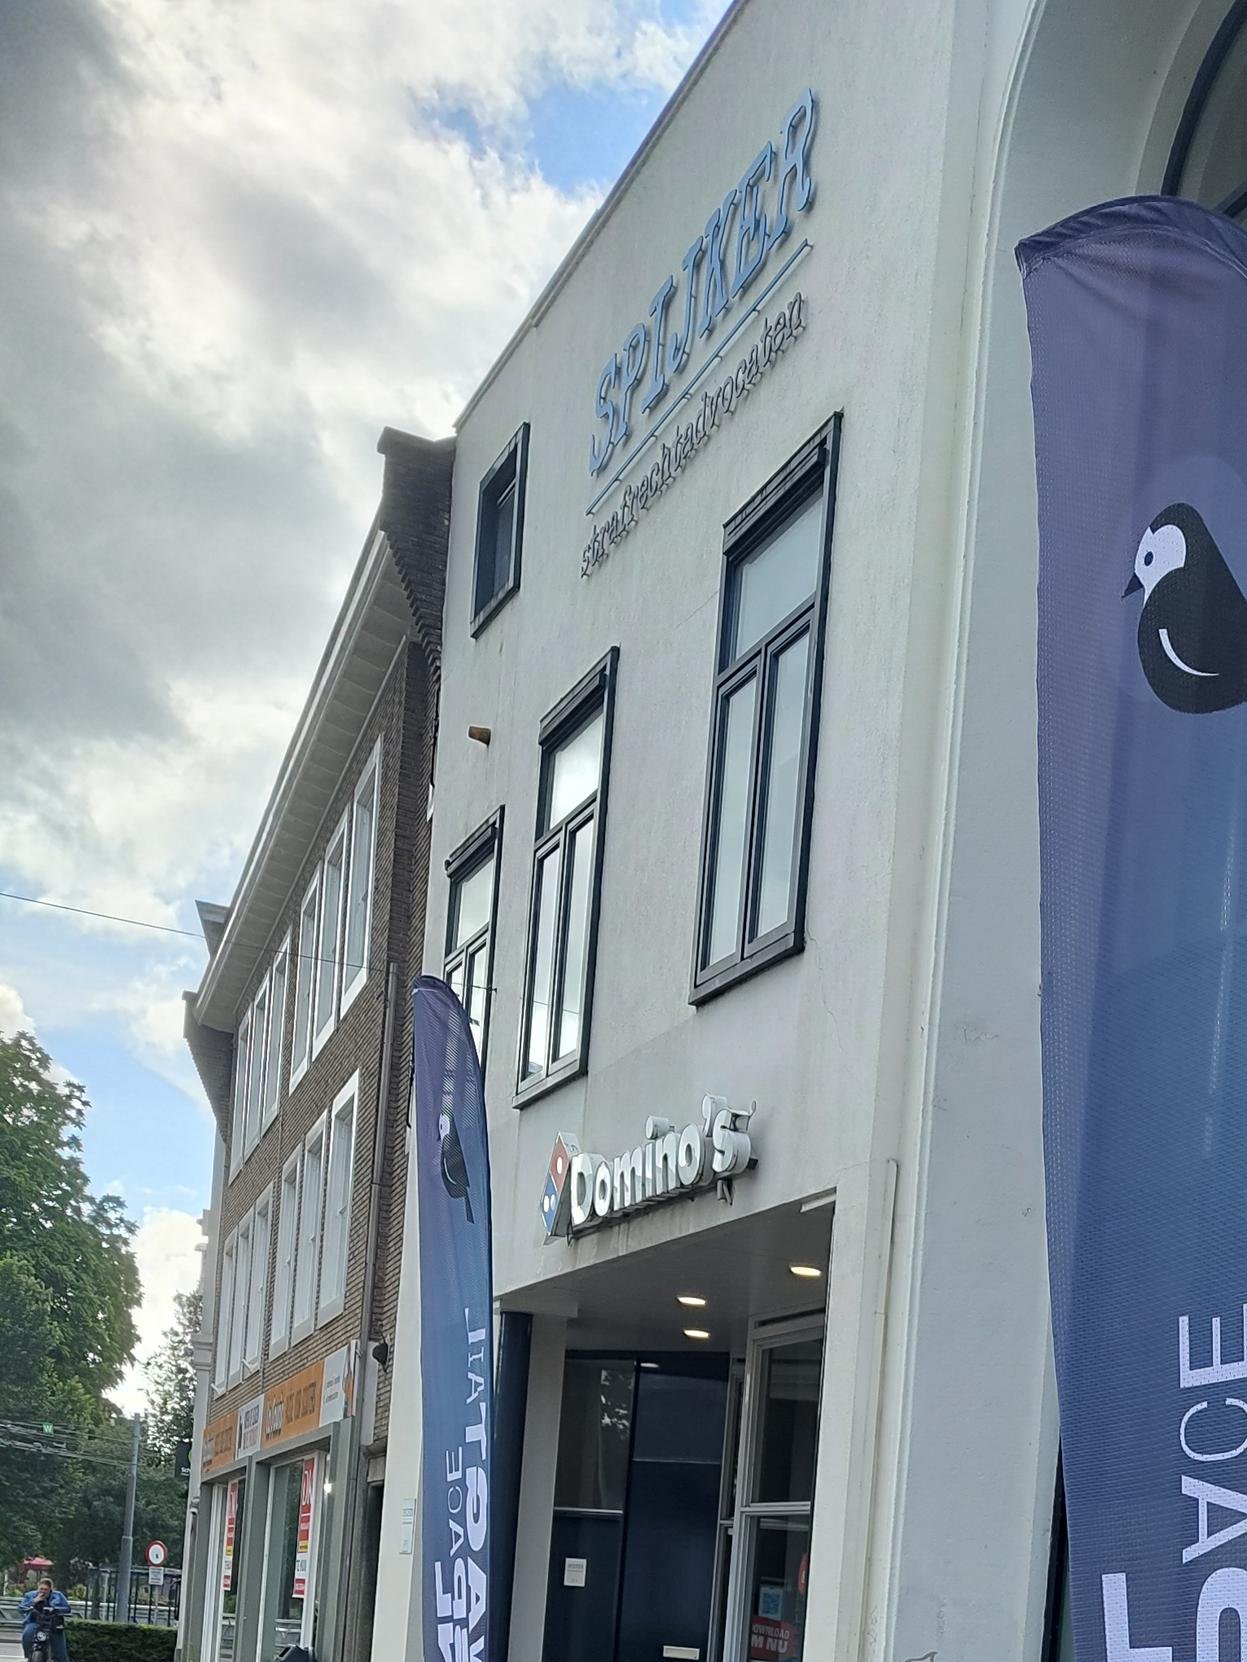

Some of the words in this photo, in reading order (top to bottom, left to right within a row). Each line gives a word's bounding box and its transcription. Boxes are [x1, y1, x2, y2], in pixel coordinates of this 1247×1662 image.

[588, 87, 816, 477] SPIJKER
[579, 291, 807, 579] strafrechtadvocaten
[570, 1094, 752, 1228] Domino's
